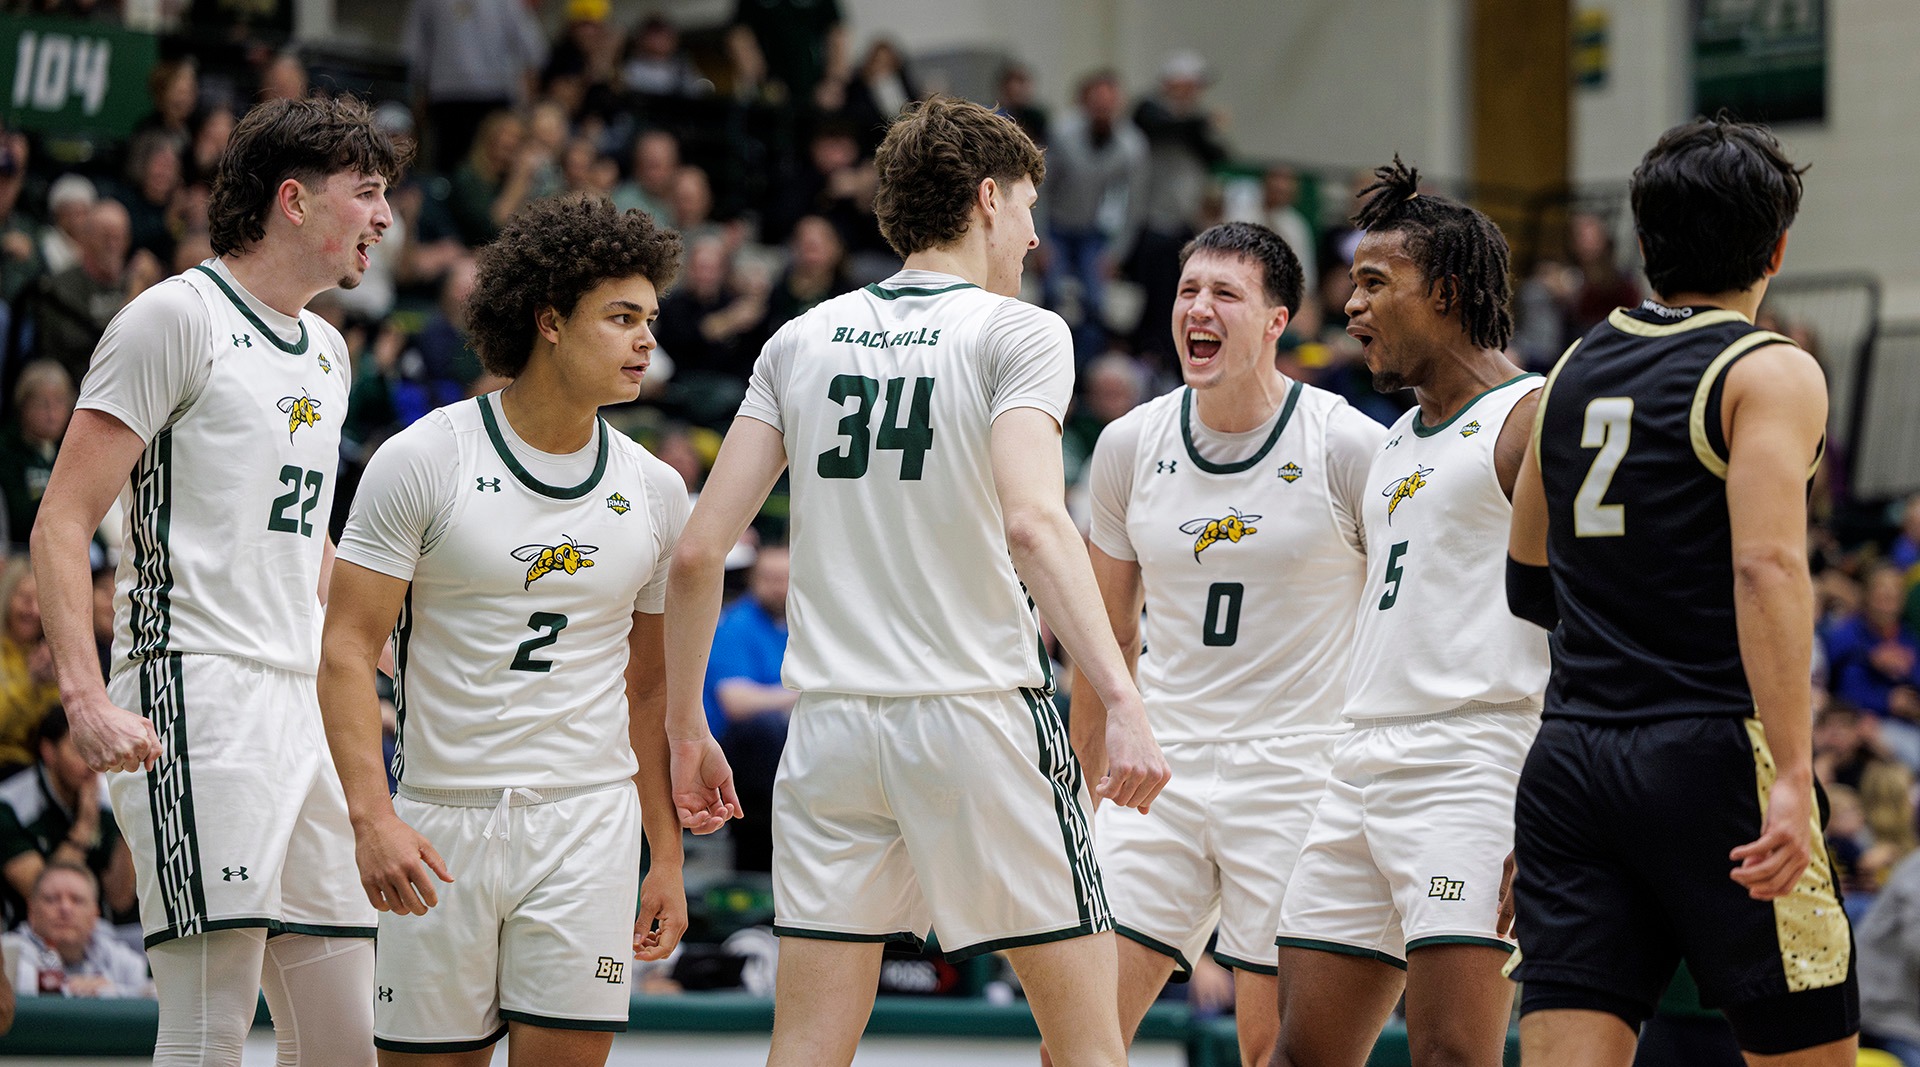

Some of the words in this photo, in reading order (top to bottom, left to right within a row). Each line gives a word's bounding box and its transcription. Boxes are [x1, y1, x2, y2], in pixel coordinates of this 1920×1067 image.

[12, 31, 110, 115] 104
[831, 327, 889, 349] BLACK
[890, 328, 941, 347] HILLS
[817, 374, 936, 481] 34
[1277, 467, 1303, 478] RMAC
[1573, 397, 1635, 538] 2
[267, 464, 324, 538] 22
[606, 498, 631, 511] RMAC
[1378, 540, 1409, 611] 5
[510, 611, 569, 673] 2
[1203, 582, 1245, 647] 0
[1428, 876, 1465, 901] BH
[595, 956, 624, 984] BH
